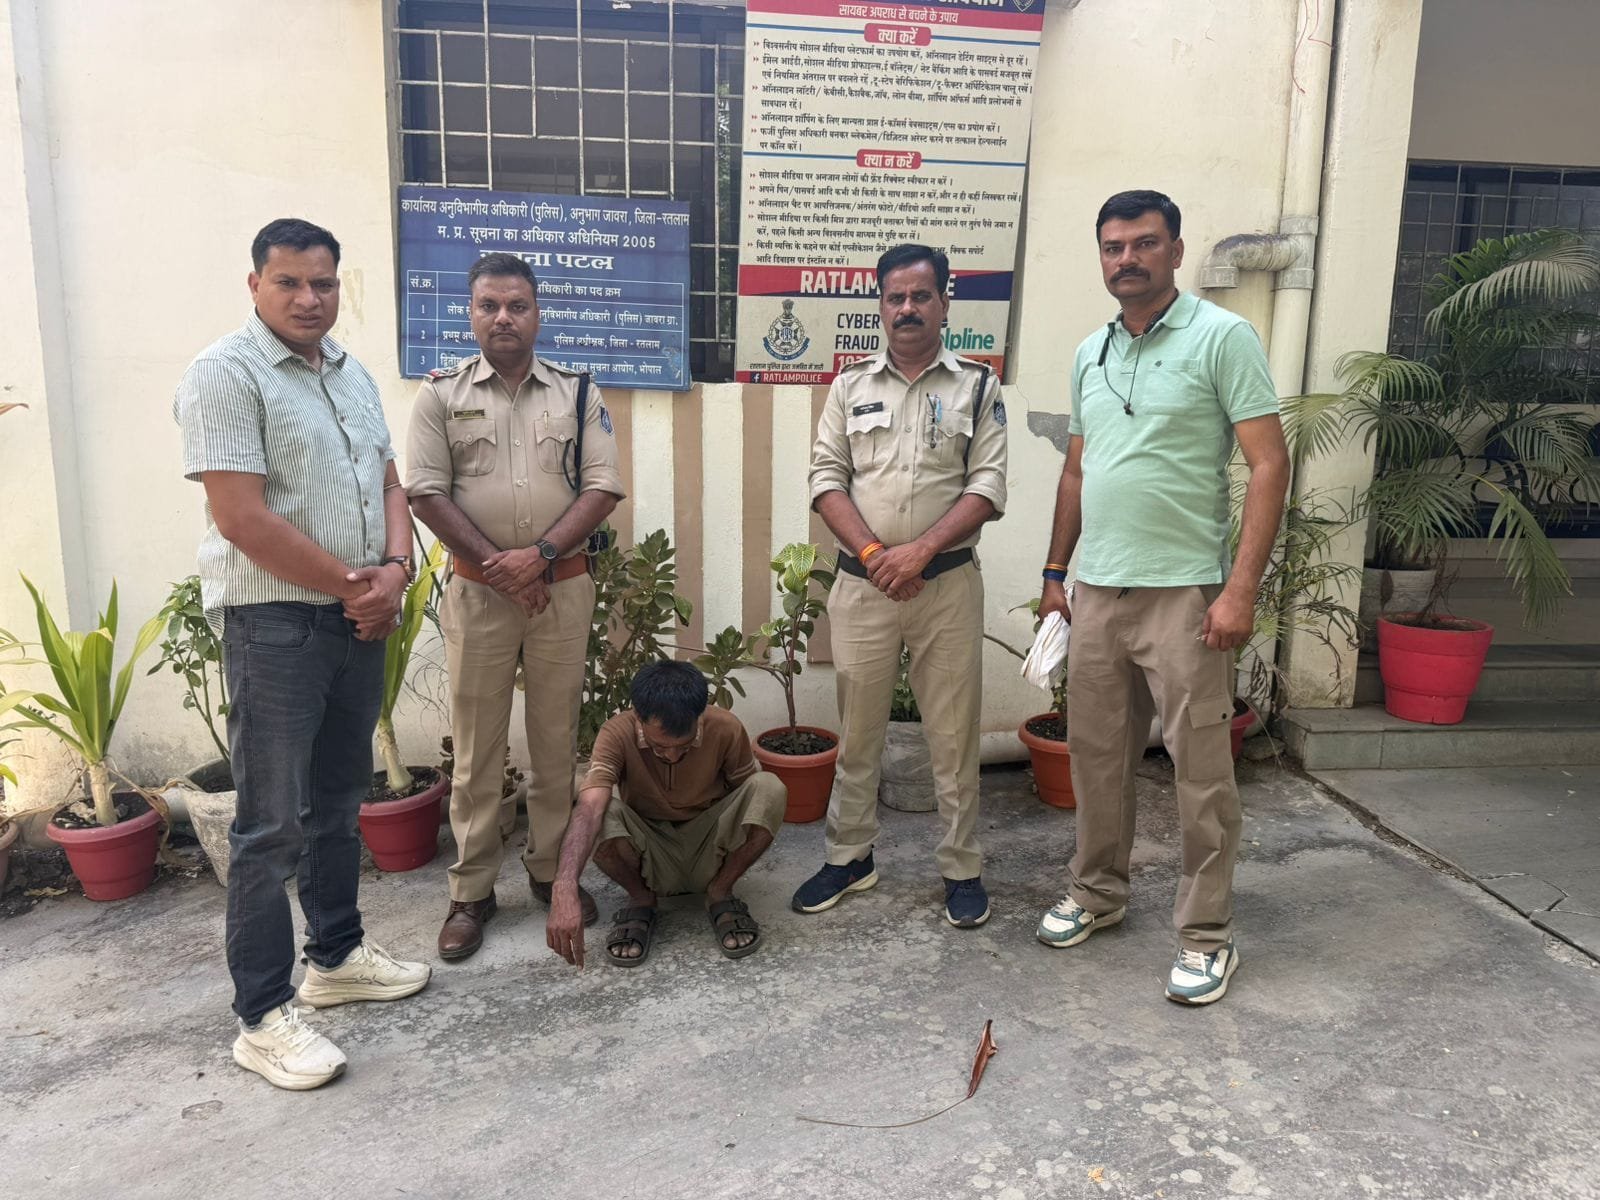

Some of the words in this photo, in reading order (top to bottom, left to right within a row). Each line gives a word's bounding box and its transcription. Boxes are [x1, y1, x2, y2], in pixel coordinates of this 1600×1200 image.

[838, 4, 868, 17] सायबर
[870, 7, 897, 19] अपराध
[898, 5, 907, 19] से
[908, 7, 928, 22] बचने
[929, 9, 938, 22] के
[938, 11, 960, 24] उपाय
[878, 28, 896, 43] क्या
[899, 28, 918, 45] करें
[799, 40, 821, 53] सोशल
[822, 42, 846, 54] मीडिया
[876, 48, 886, 56] का
[887, 46, 909, 58] उपयोग
[925, 49, 957, 62] ऑनलाइन
[1006, 56, 1015, 66] दूर
[826, 57, 850, 69] मीडिया
[920, 62, 931, 74] नेट
[952, 65, 968, 76] आदि
[773, 68, 800, 80] नियमित
[802, 70, 827, 82] अंतराल
[827, 74, 837, 82] पर
[762, 83, 794, 95] ऑनलाइन
[892, 89, 907, 100] लोन
[972, 94, 987, 105] आदि
[761, 99, 787, 108] सावधान
[761, 112, 793, 123] ऑनलाइन
[826, 114, 840, 126] लिए
[841, 117, 865, 126] मान्यता
[957, 123, 966, 131] का
[967, 121, 985, 132] प्रयोग
[777, 126, 797, 138] पुलिस
[799, 127, 828, 138] अधिकारी
[829, 130, 849, 139] बनकर
[929, 133, 944, 144] करने
[945, 136, 954, 144] पर
[954, 136, 977, 145] तत्काल
[759, 141, 769, 150] पर
[769, 140, 786, 150] कॉल
[864, 153, 883, 167] क्या
[884, 154, 894, 168] न
[896, 152, 914, 169] करें
[759, 168, 780, 180] सोशल
[781, 169, 804, 180] मीडिया
[805, 173, 814, 181] पर
[815, 173, 841, 182] अनजान
[841, 171, 859, 183] लोगों
[860, 172, 869, 183] की
[758, 183, 775, 194] अपने
[817, 185, 833, 196] आदि
[834, 186, 850, 196] कभी
[851, 186, 860, 197] भी
[861, 186, 878, 197] किसी
[887, 190, 901, 198] साथ
[401, 196, 437, 213] कार्यालय
[439, 198, 489, 219] अनुविभागीय
[490, 200, 528, 217] अधिकारी
[570, 208, 601, 225] अनुभाग
[758, 198, 790, 209] ऑनलाइन
[790, 198, 802, 209] चैट
[803, 201, 812, 209] पर
[920, 203, 936, 213] आदि
[937, 206, 954, 214] साझा
[757, 211, 778, 222] सोशल
[779, 212, 801, 223] मीडिया
[802, 215, 811, 223] पर
[812, 213, 829, 224] किसी
[919, 216, 929, 226] की
[944, 217, 959, 227] करने
[959, 220, 968, 228] पर
[993, 221, 1007, 229] जमा
[437, 225, 450, 238] म.
[469, 227, 501, 244] सूचना
[503, 228, 518, 241] का
[521, 225, 565, 243] अधिकार
[568, 228, 619, 246] अधिनियम
[622, 235, 655, 248] 2005
[771, 226, 787, 237] पहले
[788, 226, 805, 237] किसी
[806, 229, 821, 237] अन्य
[856, 231, 877, 239] माध्यम
[756, 239, 773, 250] किसी
[802, 240, 818, 252] कहने
[818, 243, 828, 252] पर
[828, 241, 841, 252] कोई
[556, 253, 614, 270] पटल
[756, 253, 772, 263] आदि
[797, 256, 806, 264] पर
[574, 285, 588, 296] का
[589, 286, 603, 297] पद
[604, 287, 622, 297] क्रम
[421, 304, 425, 314] 1
[447, 301, 465, 315] लोक
[539, 306, 577, 322] नुविभागीय
[579, 308, 611, 322] अधिकारी
[614, 310, 643, 326] (पुलिस)
[644, 314, 666, 325] जावरा
[837, 313, 880, 329] CYBER
[421, 330, 425, 340] 2
[554, 332, 575, 349] पुलिस
[609, 334, 628, 348] जिला
[636, 339, 660, 349] रतलाम
[835, 334, 879, 351] FRAUD
[420, 355, 425, 365] 3
[589, 362, 610, 376] सूचना
[639, 362, 662, 374] भोपाल
[763, 373, 823, 383] RATLAMPOLICE
